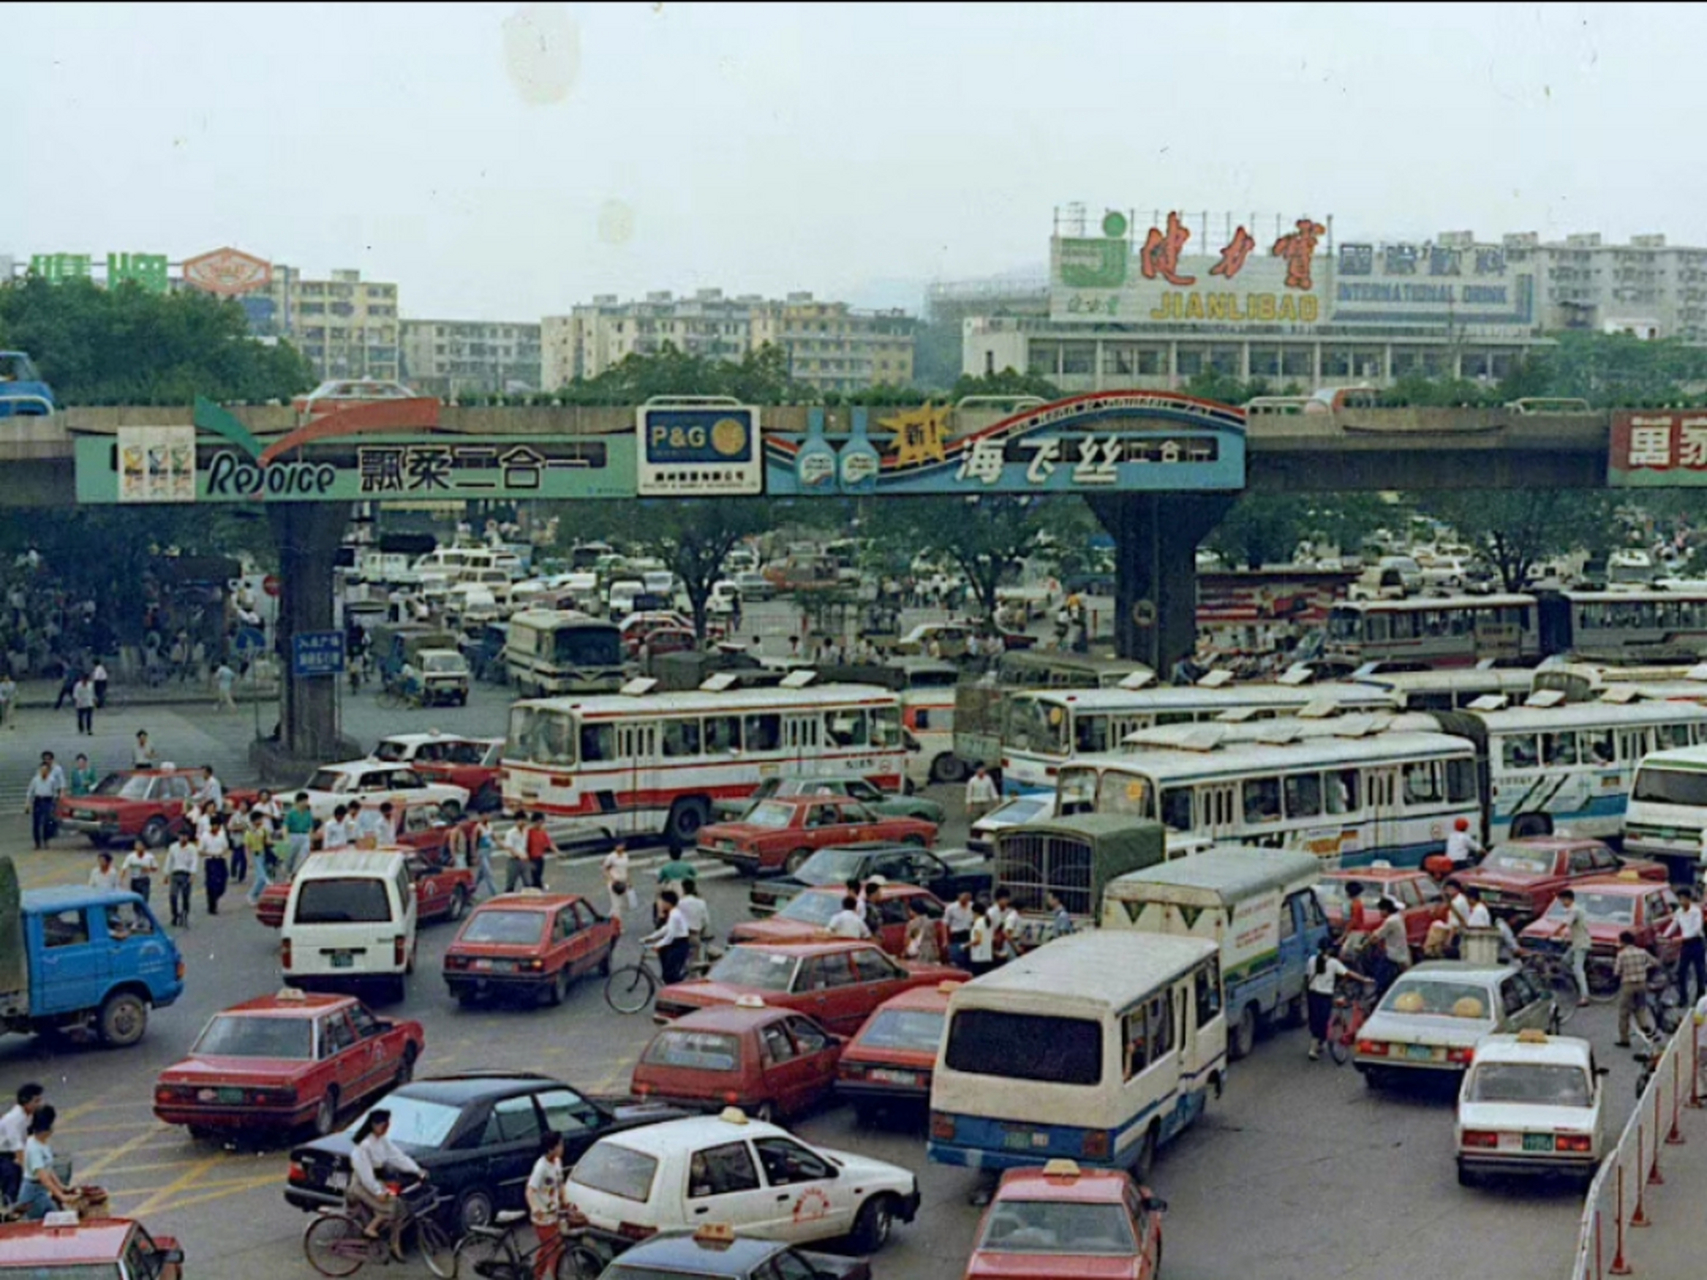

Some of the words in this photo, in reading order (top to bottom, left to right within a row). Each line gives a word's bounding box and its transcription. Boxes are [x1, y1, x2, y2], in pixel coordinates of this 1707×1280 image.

[1151, 291, 1319, 322] JIANLIBAO
[652, 426, 706, 448] P&G
[207, 450, 336, 496] Rejoice
